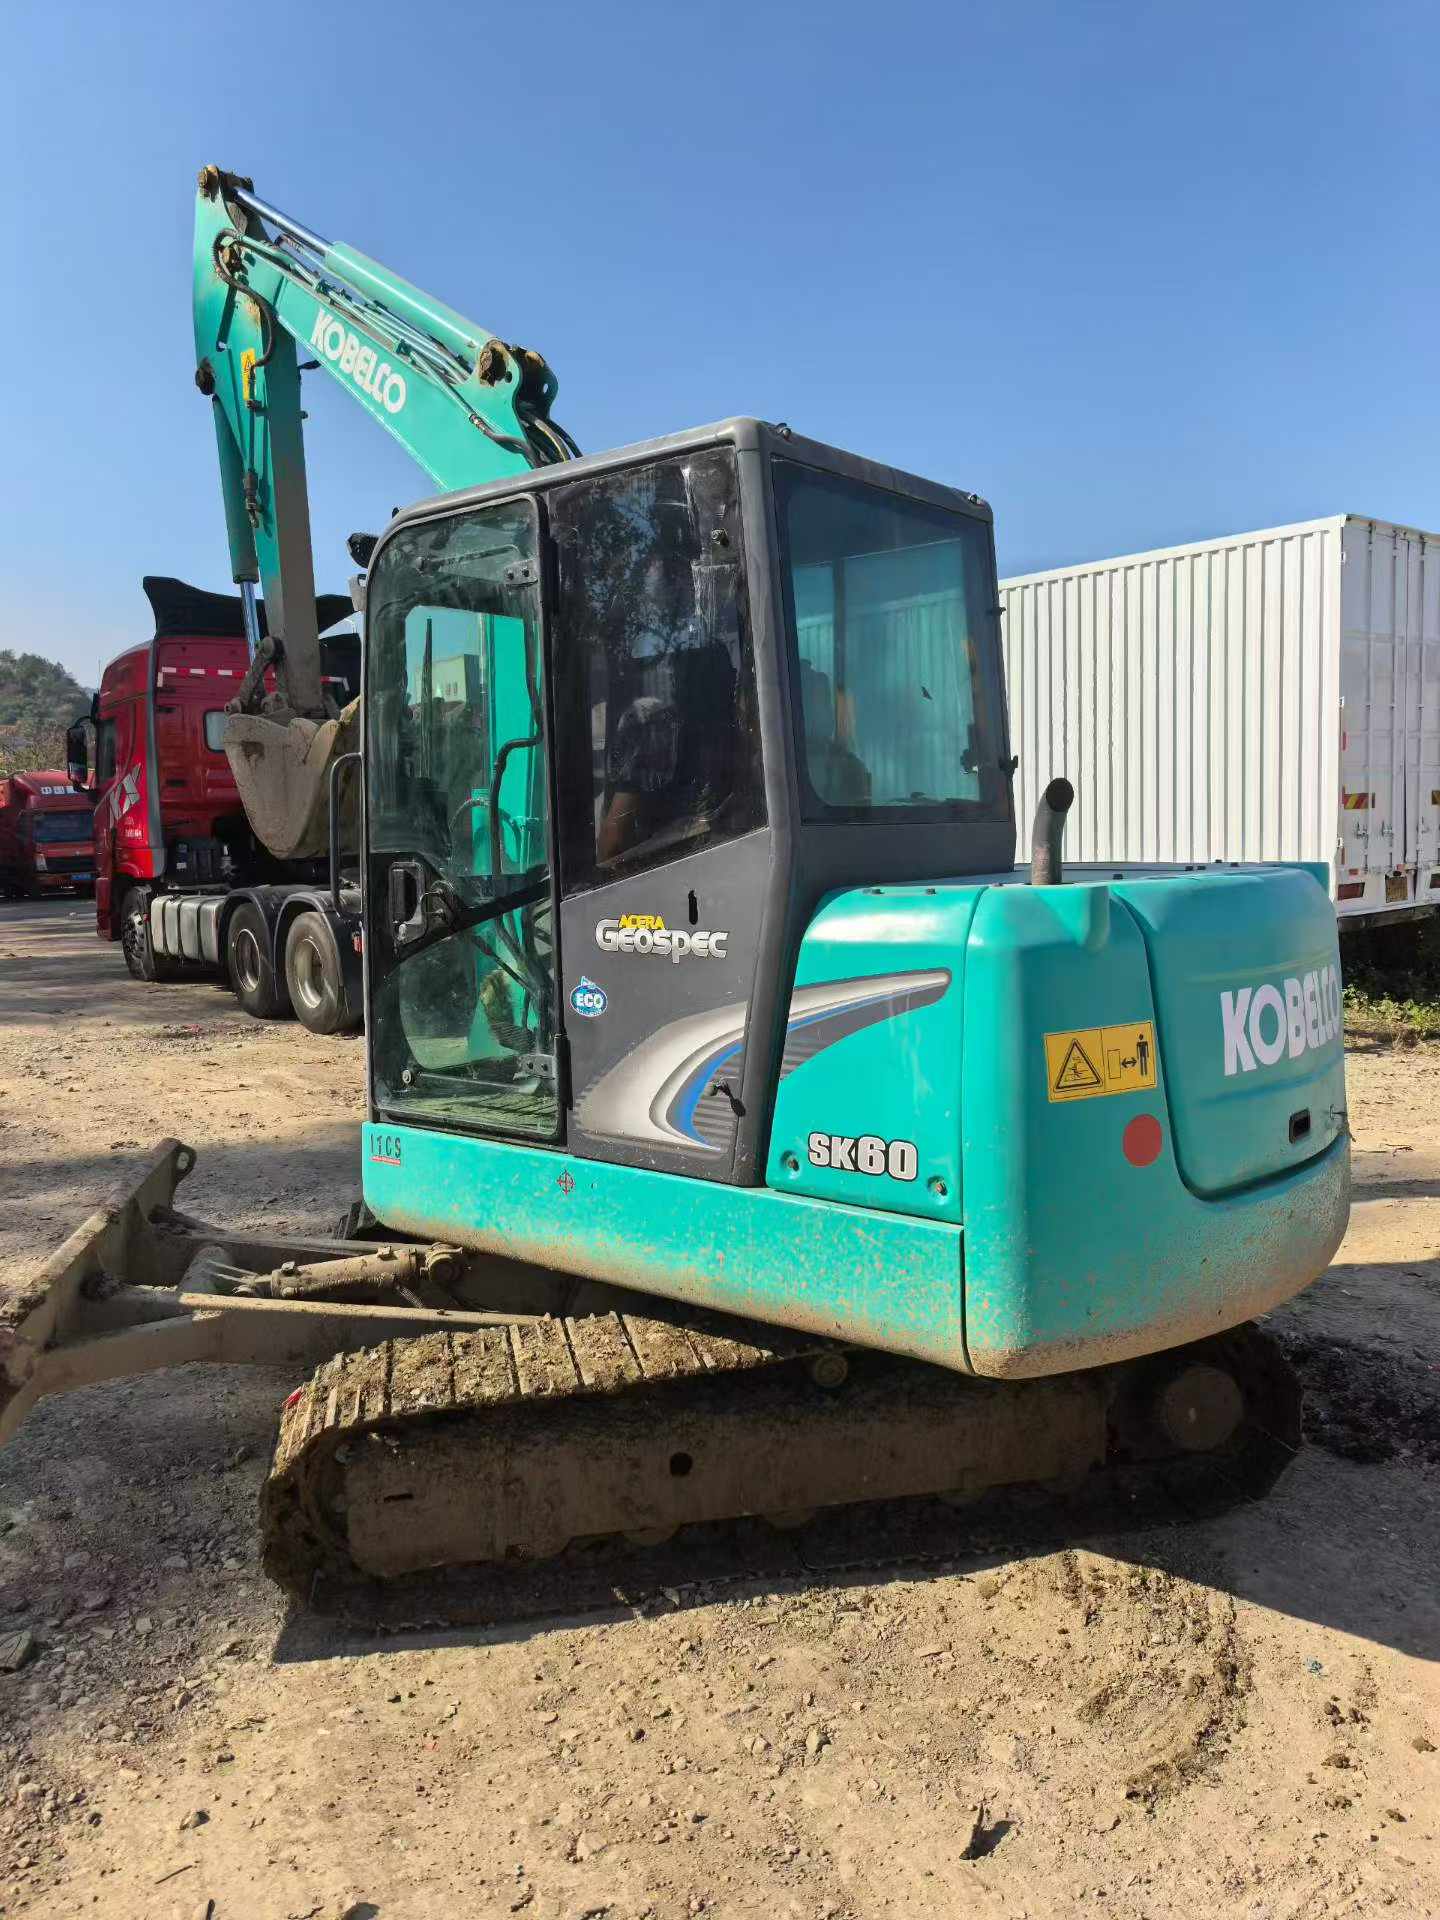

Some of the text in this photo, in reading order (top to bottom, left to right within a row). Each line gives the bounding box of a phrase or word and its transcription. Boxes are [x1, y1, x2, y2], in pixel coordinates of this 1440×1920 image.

[309, 307, 407, 414] KOBELCO
[619, 914, 665, 930] ACERA
[576, 992, 604, 1009] ECO
[1220, 964, 1341, 1077] KOBELCO
[807, 1130, 919, 1182] SK60
